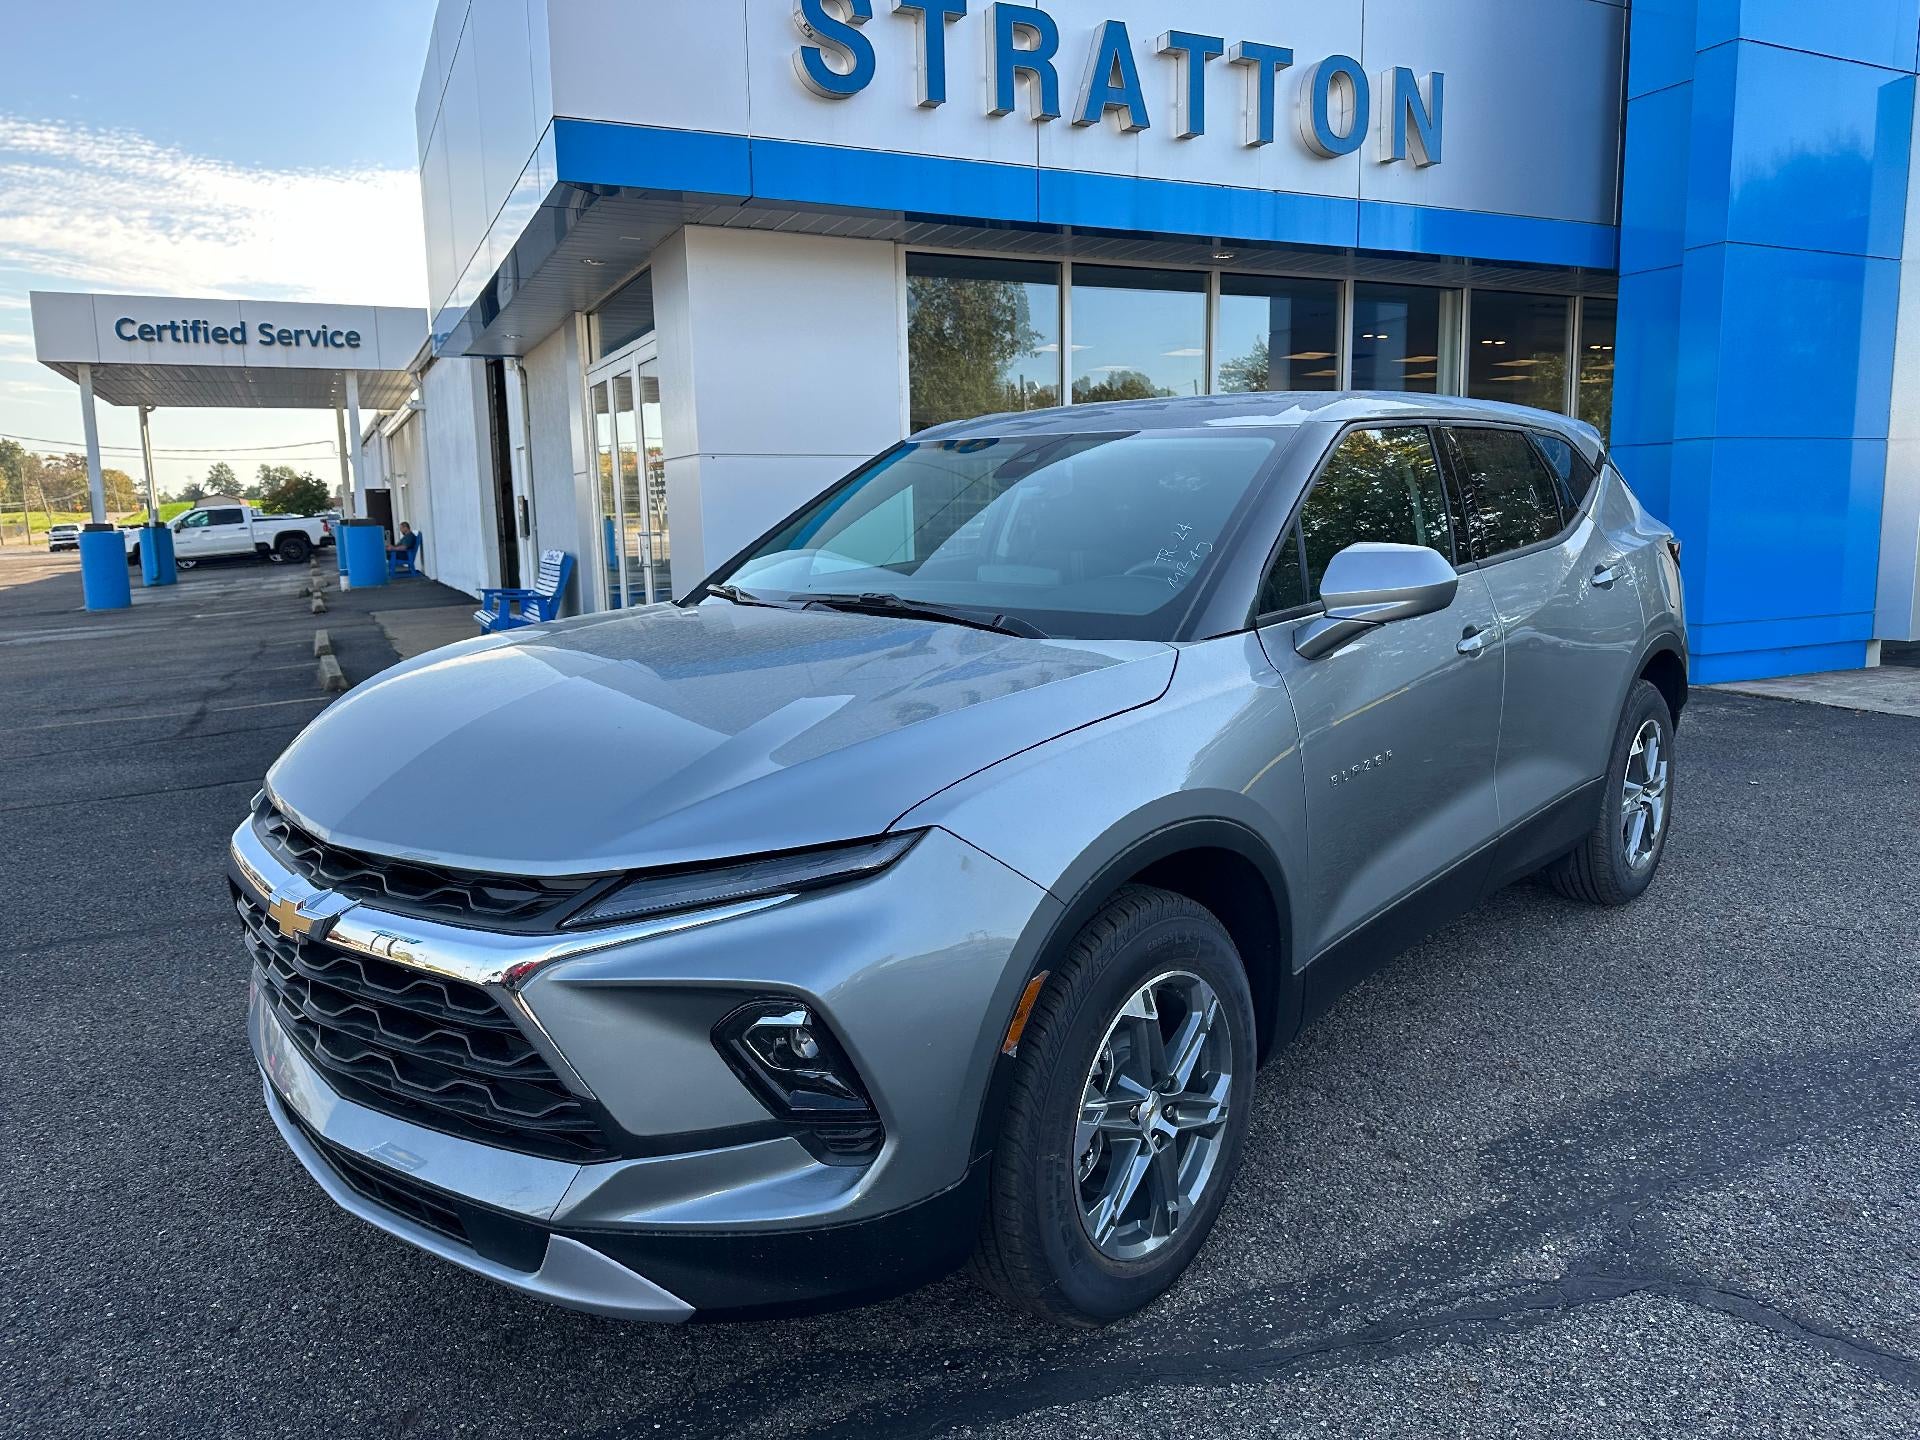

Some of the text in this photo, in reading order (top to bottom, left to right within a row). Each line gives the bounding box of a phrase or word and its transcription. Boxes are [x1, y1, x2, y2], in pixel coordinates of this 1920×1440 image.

[793, 0, 1444, 168] STRATTON
[115, 317, 361, 348] Certified Service
[1329, 749, 1393, 787] BLAZER
